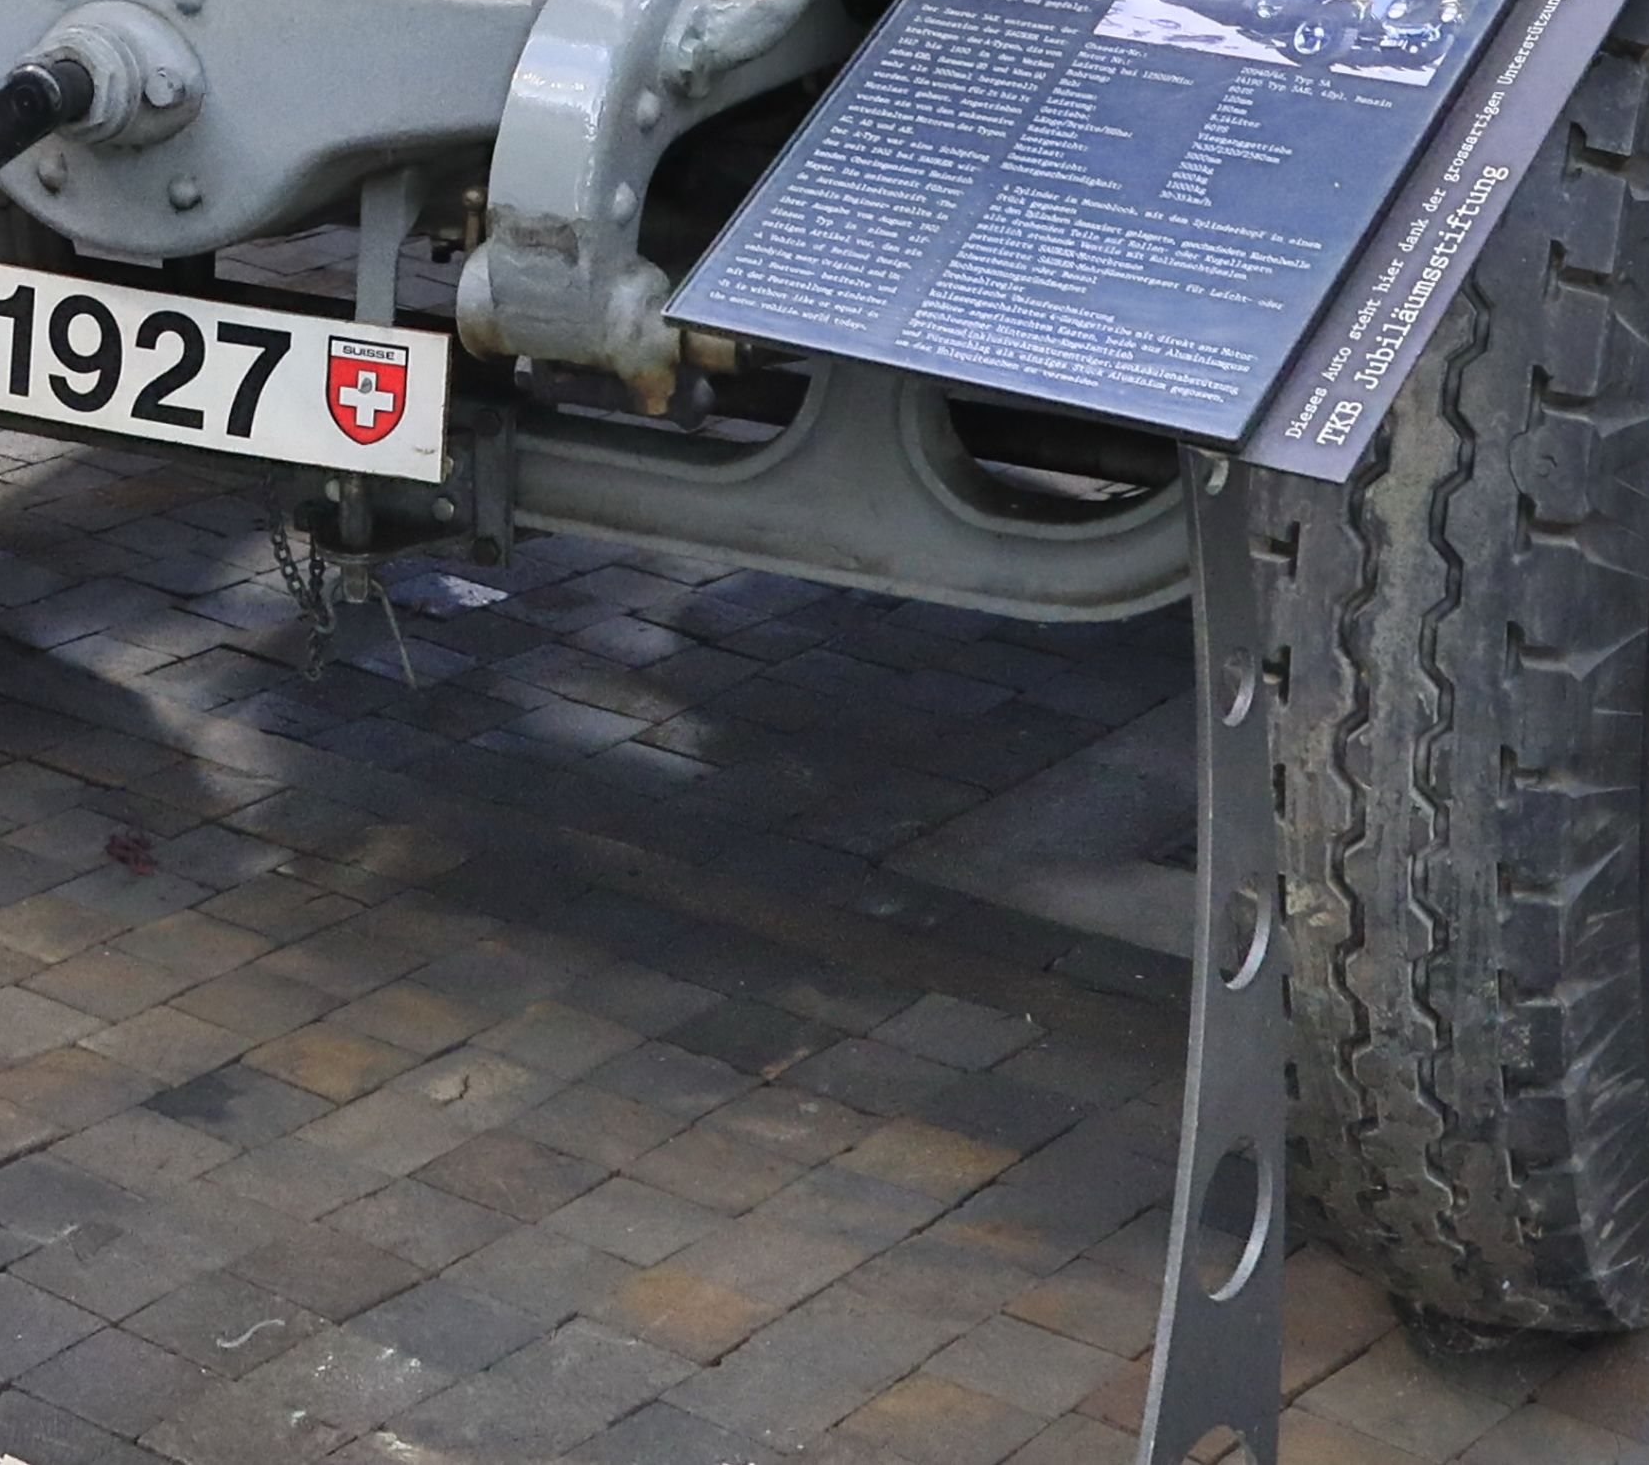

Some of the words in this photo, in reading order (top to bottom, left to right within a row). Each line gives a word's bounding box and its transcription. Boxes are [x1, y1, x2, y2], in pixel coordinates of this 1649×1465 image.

[342, 345, 395, 361] SUISSE
[1285, 386, 1328, 440] Dieses
[1322, 347, 1352, 382] Auto
[1349, 298, 1382, 341] steht
[1372, 259, 1404, 294] hier
[1398, 218, 1430, 253] dank
[1422, 187, 1446, 213] der
[1443, 91, 1505, 183] grossartigen
[1316, 400, 1364, 446] TKB
[1354, 165, 1509, 391] Jubiläumsstiftung
